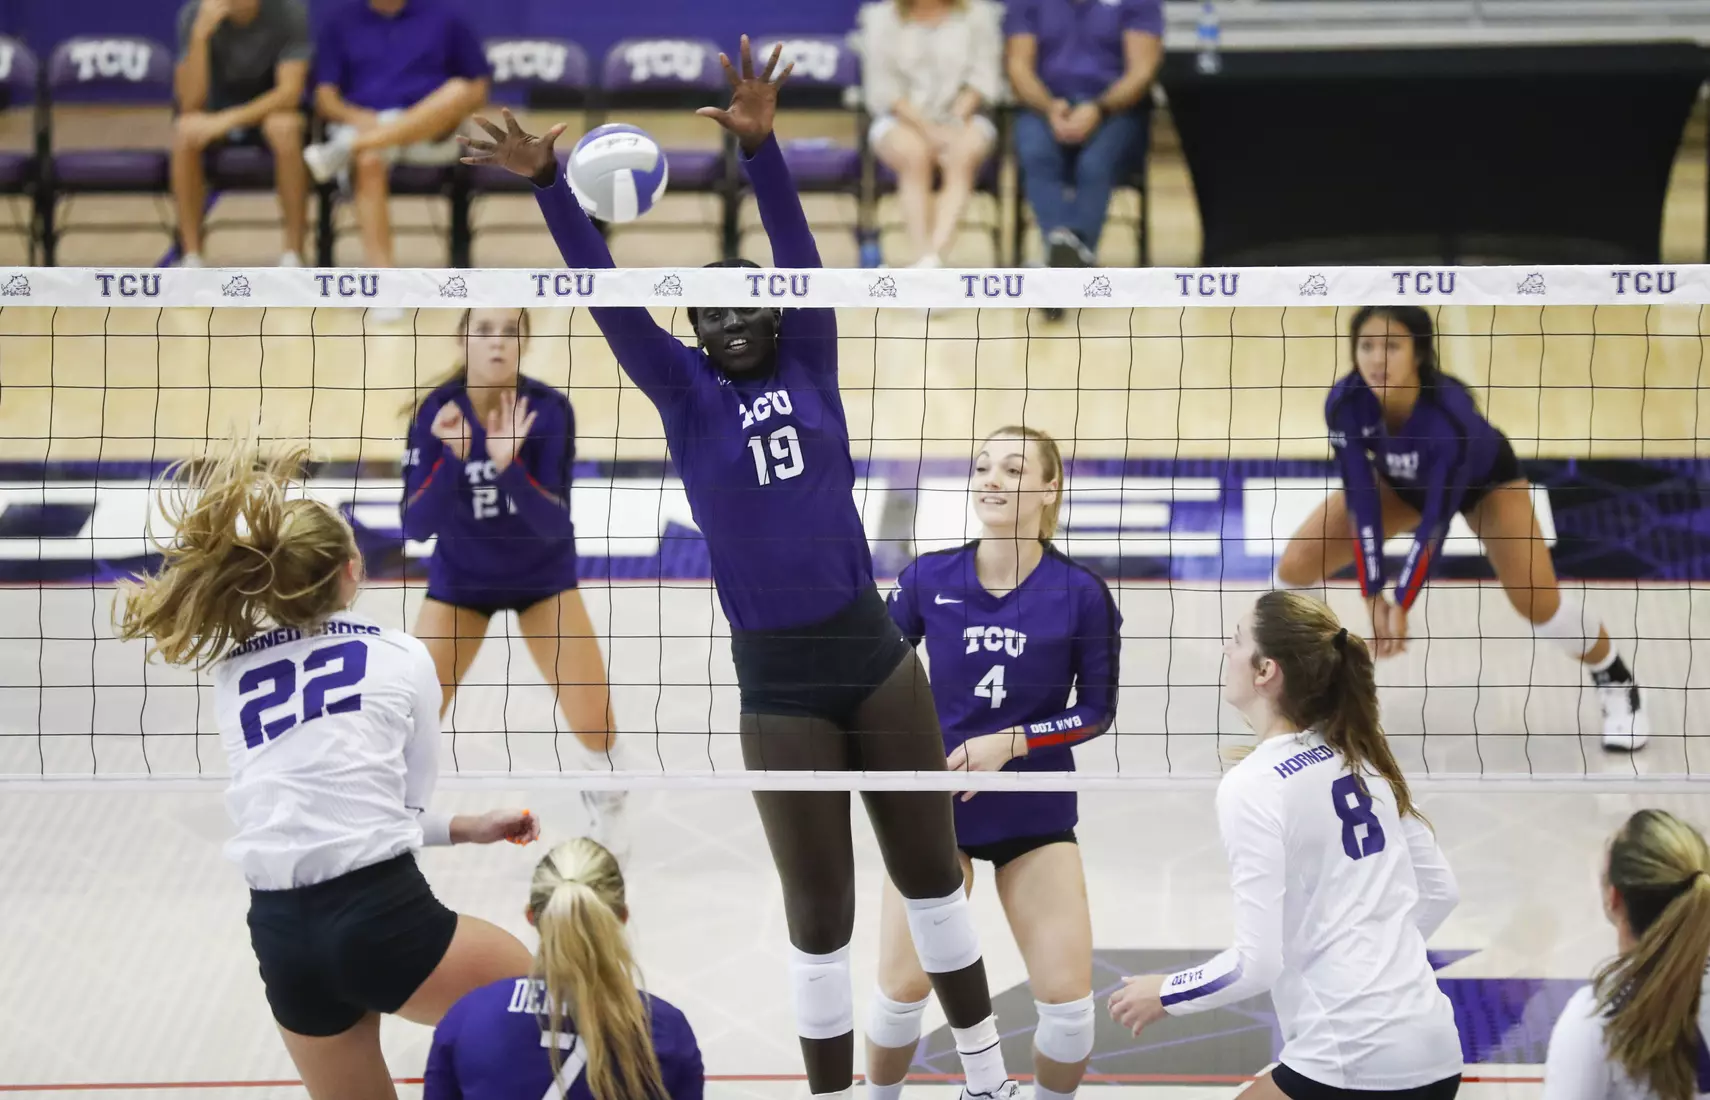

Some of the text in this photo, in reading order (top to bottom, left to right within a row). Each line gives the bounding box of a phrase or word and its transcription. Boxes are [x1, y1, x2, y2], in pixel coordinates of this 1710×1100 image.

[70, 40, 151, 81] TCU
[486, 40, 568, 82] TCU
[624, 40, 705, 82] TCU
[95, 273, 161, 297] TCU
[313, 273, 380, 298] TCU
[530, 272, 595, 297] TCU
[745, 273, 811, 298] TCU
[959, 273, 1025, 298] TCU
[1174, 272, 1240, 297] TCU
[1391, 270, 1456, 295] TCU
[1611, 269, 1677, 294] TCU
[747, 425, 805, 486] 19
[963, 625, 1027, 659] TCU
[238, 640, 368, 750] 22
[974, 664, 1007, 709] 4
[1030, 721, 1055, 734] ZOO
[1273, 744, 1335, 780] HORNED
[1331, 773, 1386, 861] 8
[540, 1030, 589, 1100] 7
